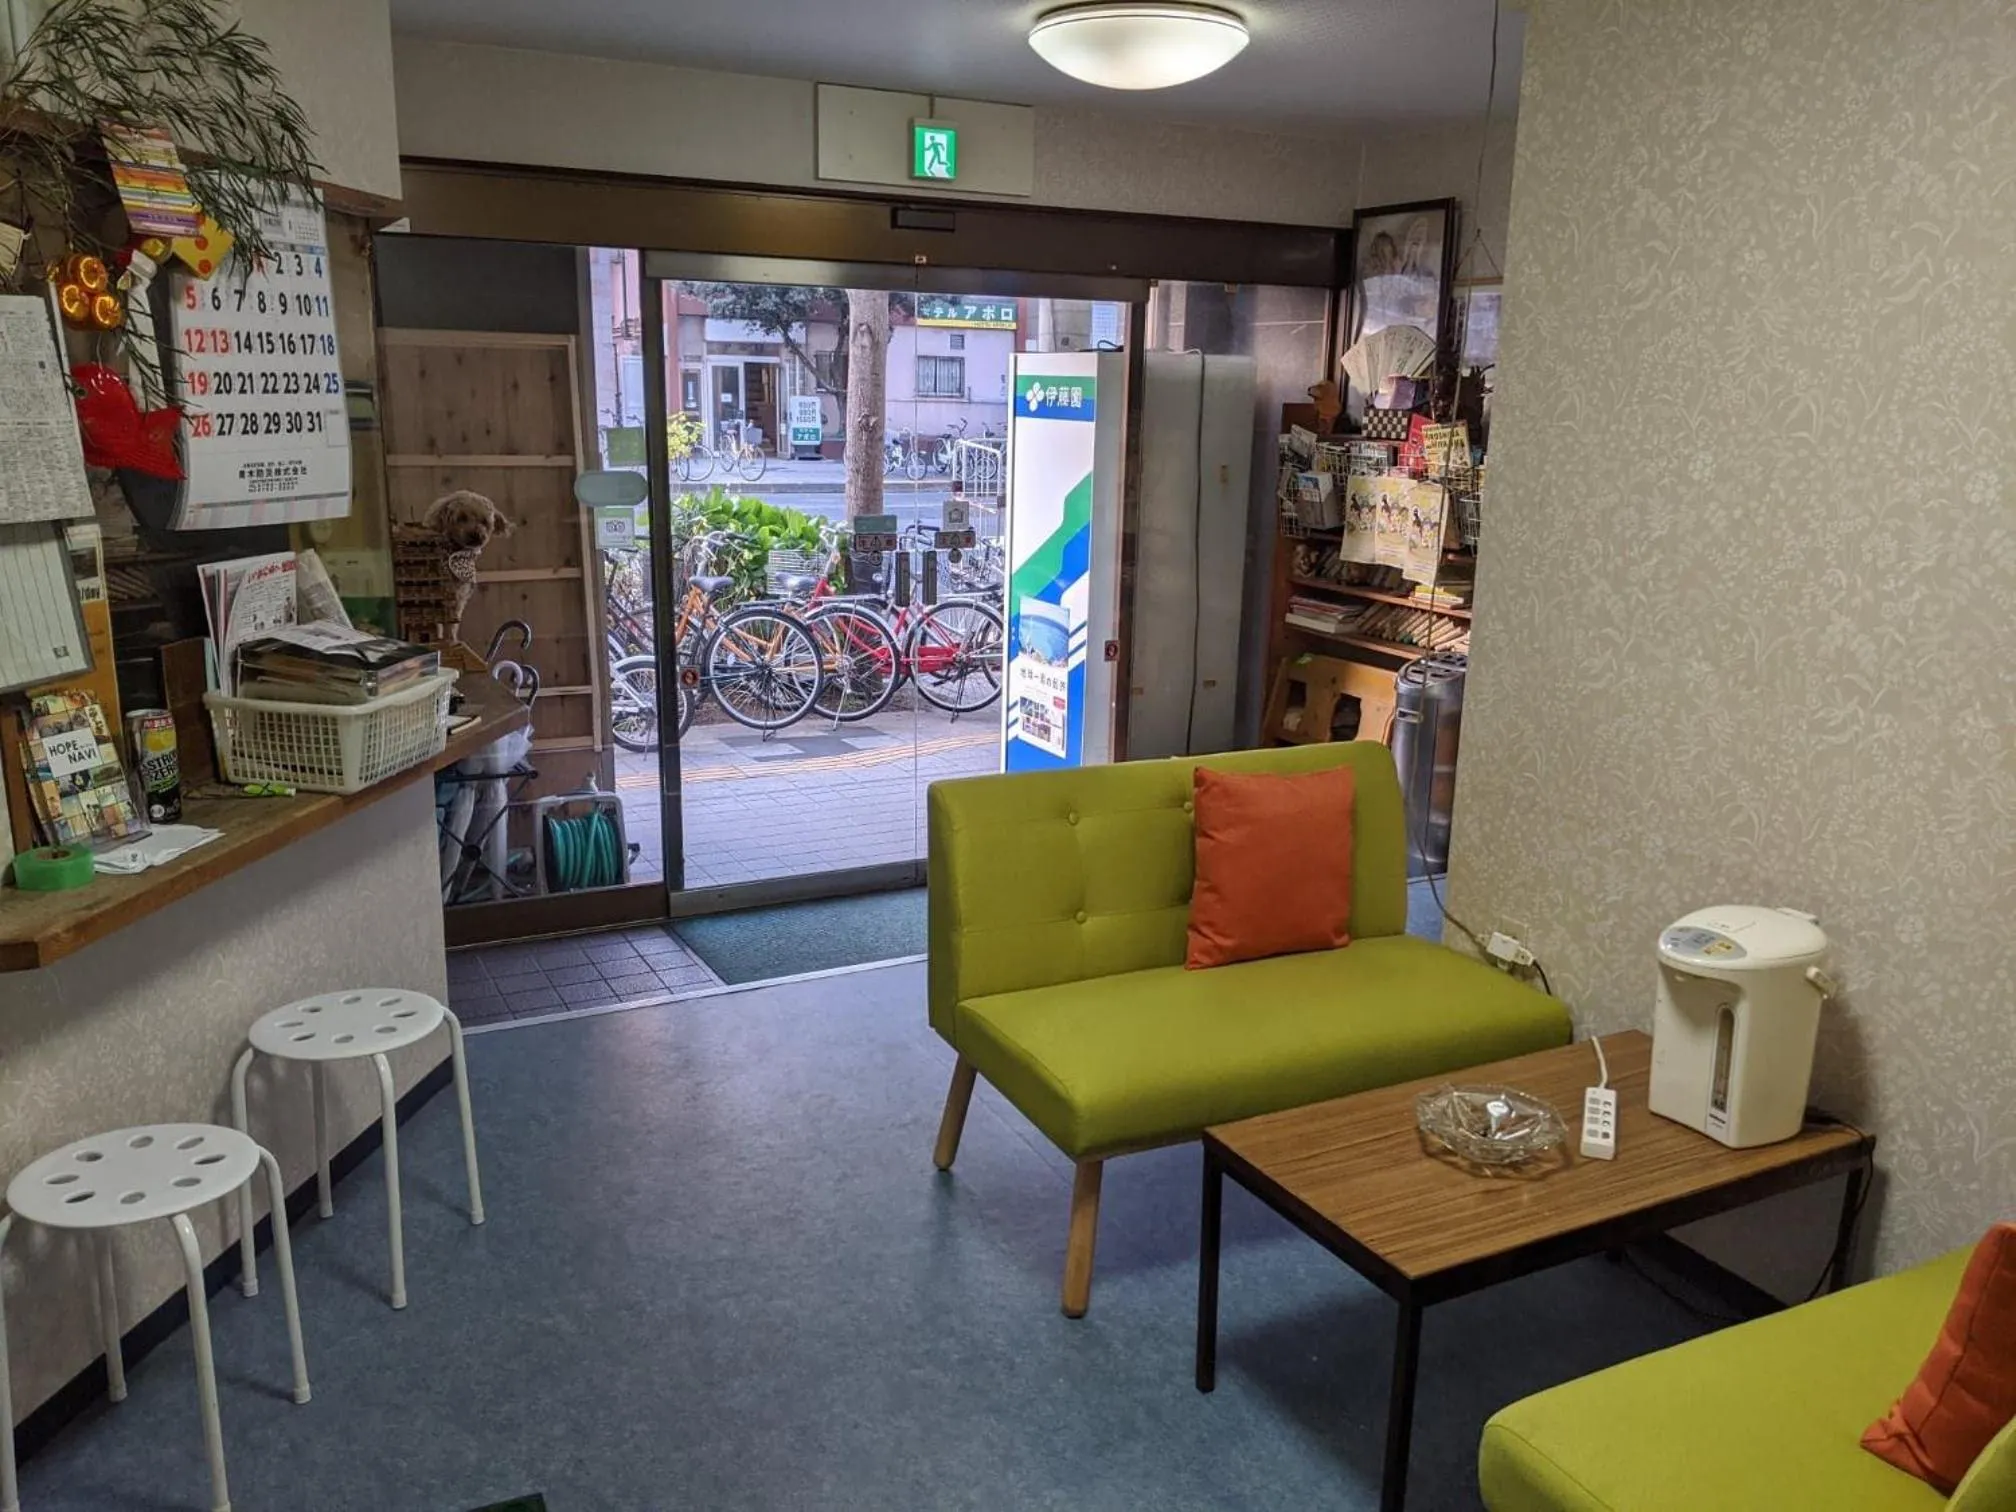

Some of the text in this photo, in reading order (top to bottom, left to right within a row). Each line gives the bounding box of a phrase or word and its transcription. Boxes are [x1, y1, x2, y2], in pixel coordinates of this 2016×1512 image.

[273, 252, 284, 275] 2
[294, 254, 303, 276] 3
[314, 256, 323, 278] 4
[185, 285, 330, 317] 5 6 7 8 9 10 11
[184, 328, 335, 356] 12 13 14 15 16 17 18
[188, 371, 340, 396] 19 20 21 22 23 24 25
[191, 410, 323, 438] 26 27 28 29 30 31
[48, 739, 79, 758] HOPE
[67, 748, 98, 765] NAVI
